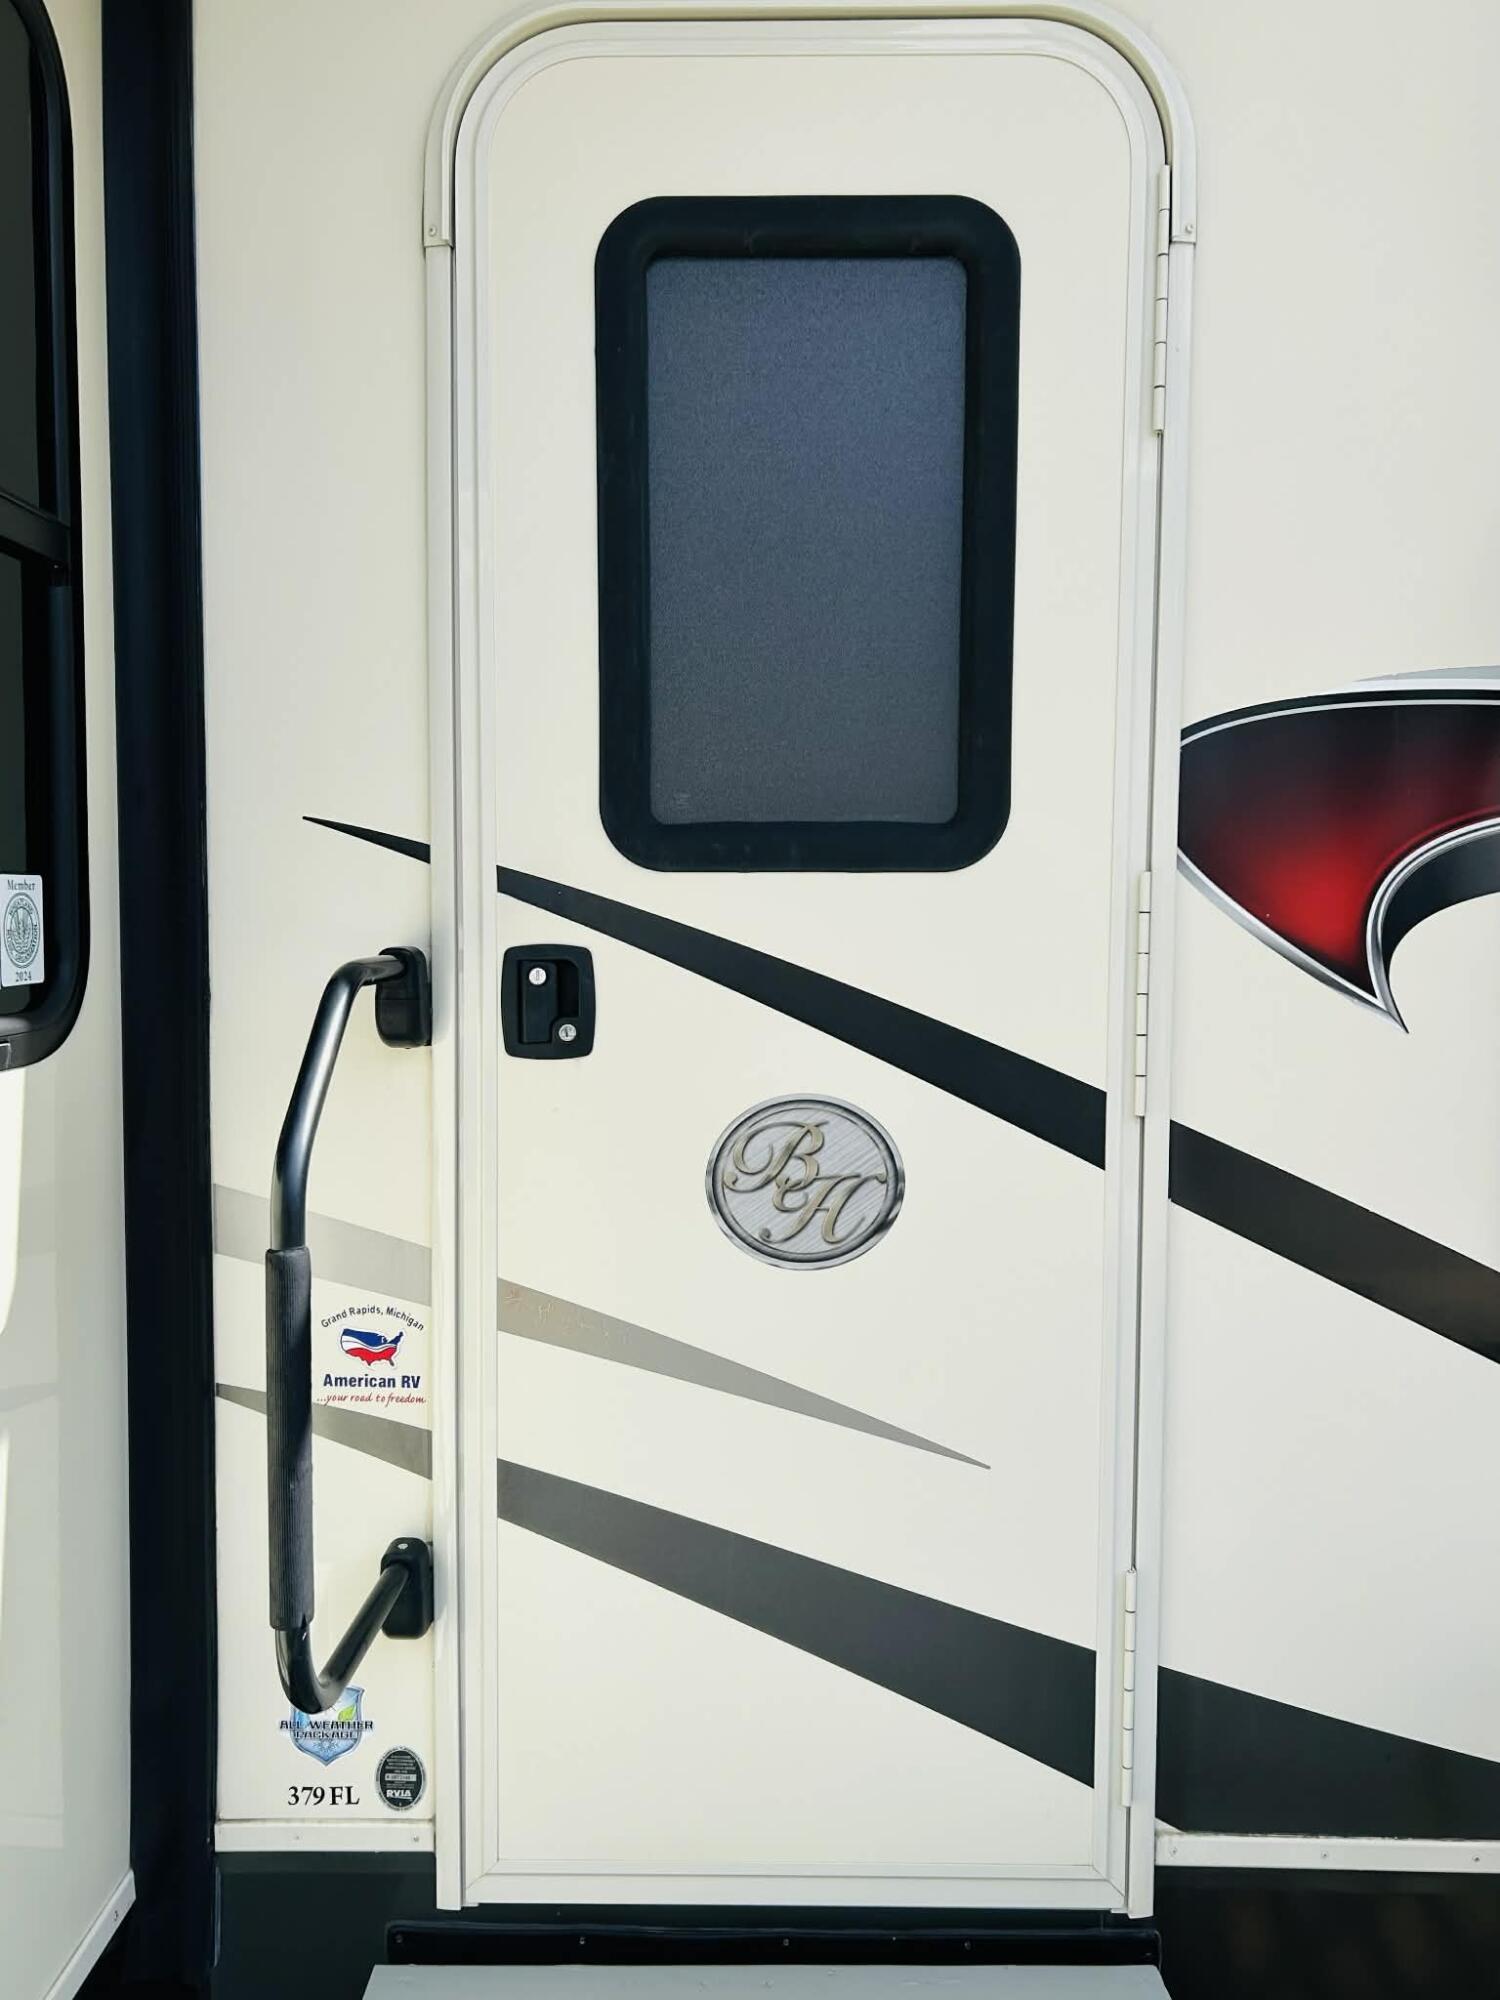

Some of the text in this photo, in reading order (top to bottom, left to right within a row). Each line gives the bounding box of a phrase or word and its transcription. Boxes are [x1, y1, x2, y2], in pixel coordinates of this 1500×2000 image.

[7, 879, 36, 891] Member
[15, 970, 32, 982] 2024
[321, 1304, 425, 1331] Grand Rapids, Michigan
[323, 1373, 421, 1389] American RV
[350, 1392, 373, 1402] road
[375, 1393, 386, 1402] to
[279, 1720, 374, 1730] ALL WEATHER
[295, 1730, 356, 1739] PACKAGE
[288, 1786, 360, 1806] 379 FL
[386, 1789, 412, 1798] RVIA
